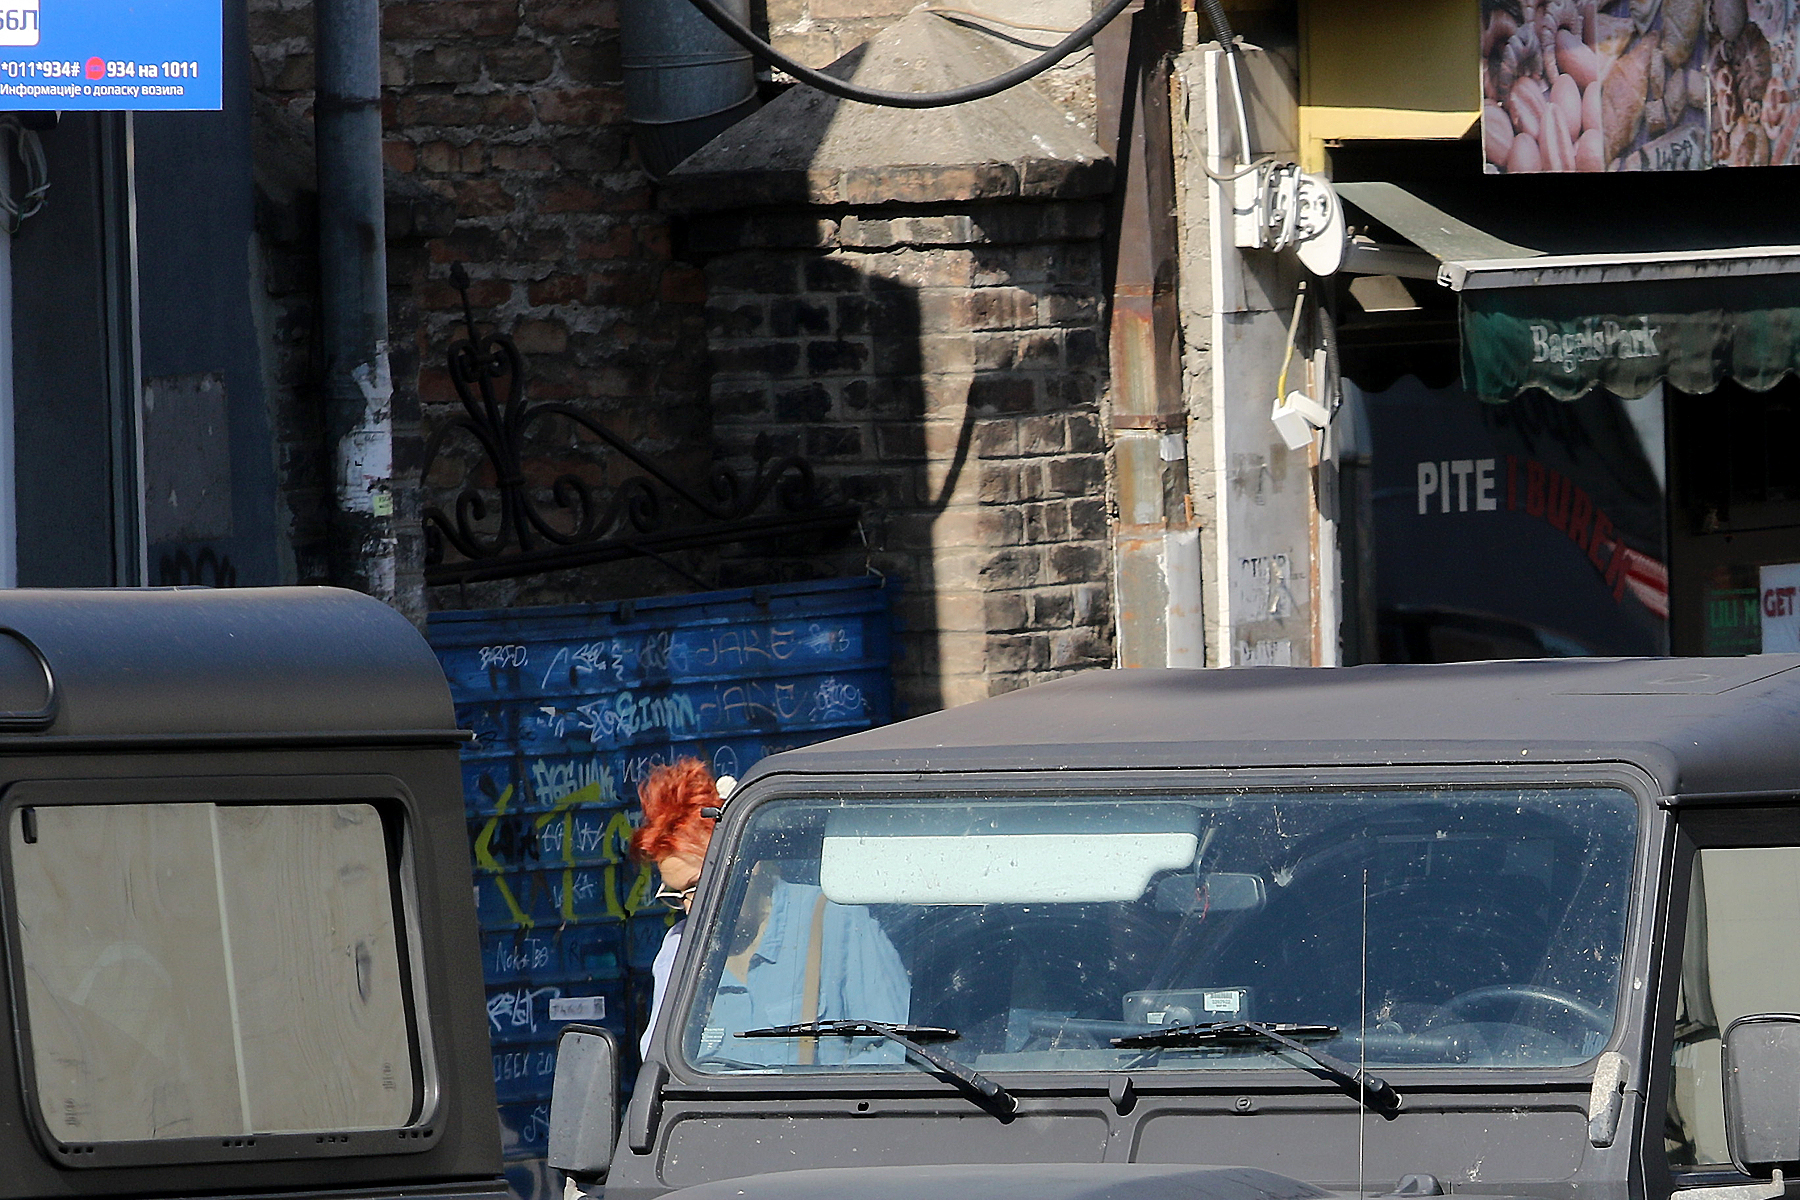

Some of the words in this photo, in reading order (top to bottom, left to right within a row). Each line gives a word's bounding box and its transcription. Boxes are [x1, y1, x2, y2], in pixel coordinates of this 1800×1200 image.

[106, 61, 135, 78] 934
[138, 64, 158, 78] на
[161, 61, 199, 78] 1011
[84, 85, 91, 95] о
[93, 84, 139, 97] доласку
[142, 85, 184, 95] возила
[1417, 458, 1497, 514] PITE
[1526, 458, 1634, 605] BUREK
[1764, 587, 1797, 618] GET
